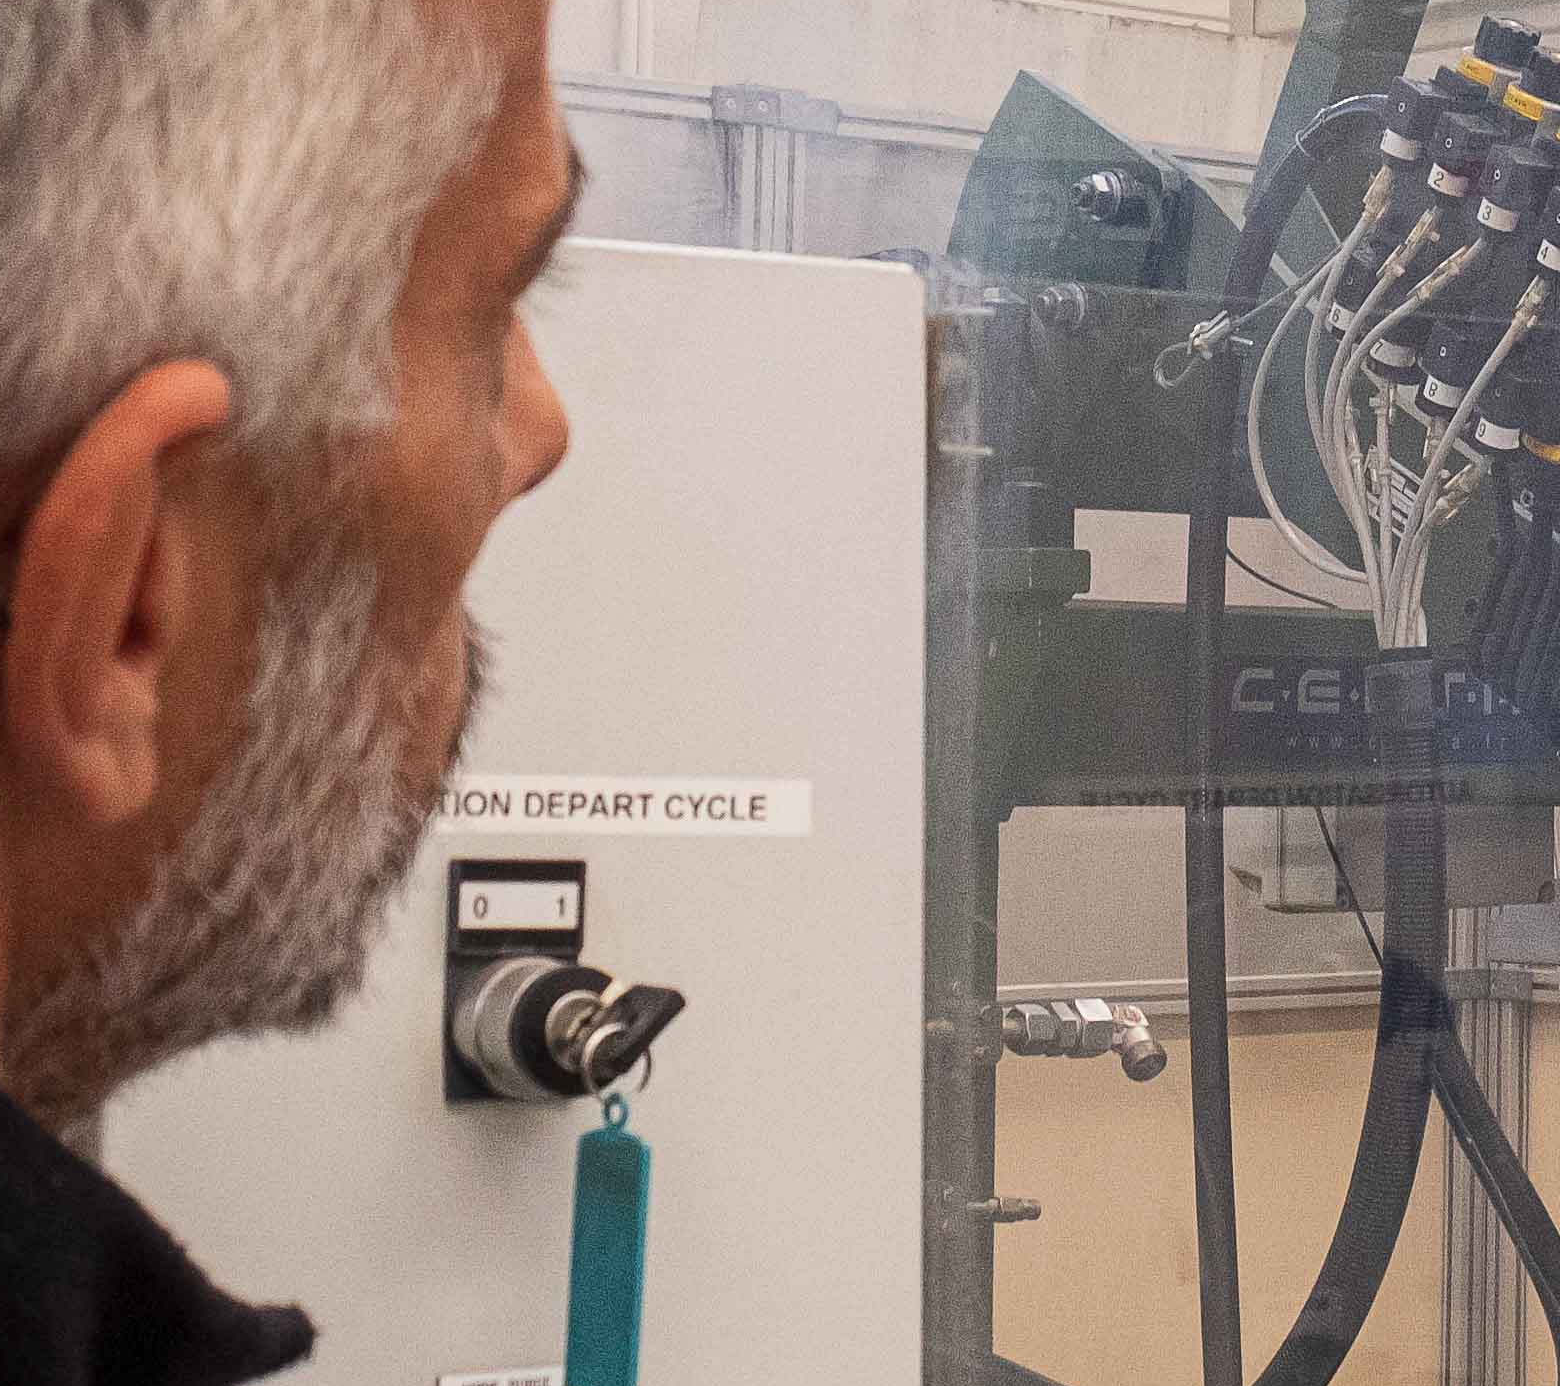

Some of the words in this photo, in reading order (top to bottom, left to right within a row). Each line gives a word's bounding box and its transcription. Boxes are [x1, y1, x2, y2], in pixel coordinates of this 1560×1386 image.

[1434, 171, 1444, 185] 2
[1482, 205, 1491, 220] 3
[1539, 246, 1549, 260] 4
[525, 792, 653, 820] DEPART
[664, 795, 768, 822] CYCLE
[557, 896, 566, 918] 1
